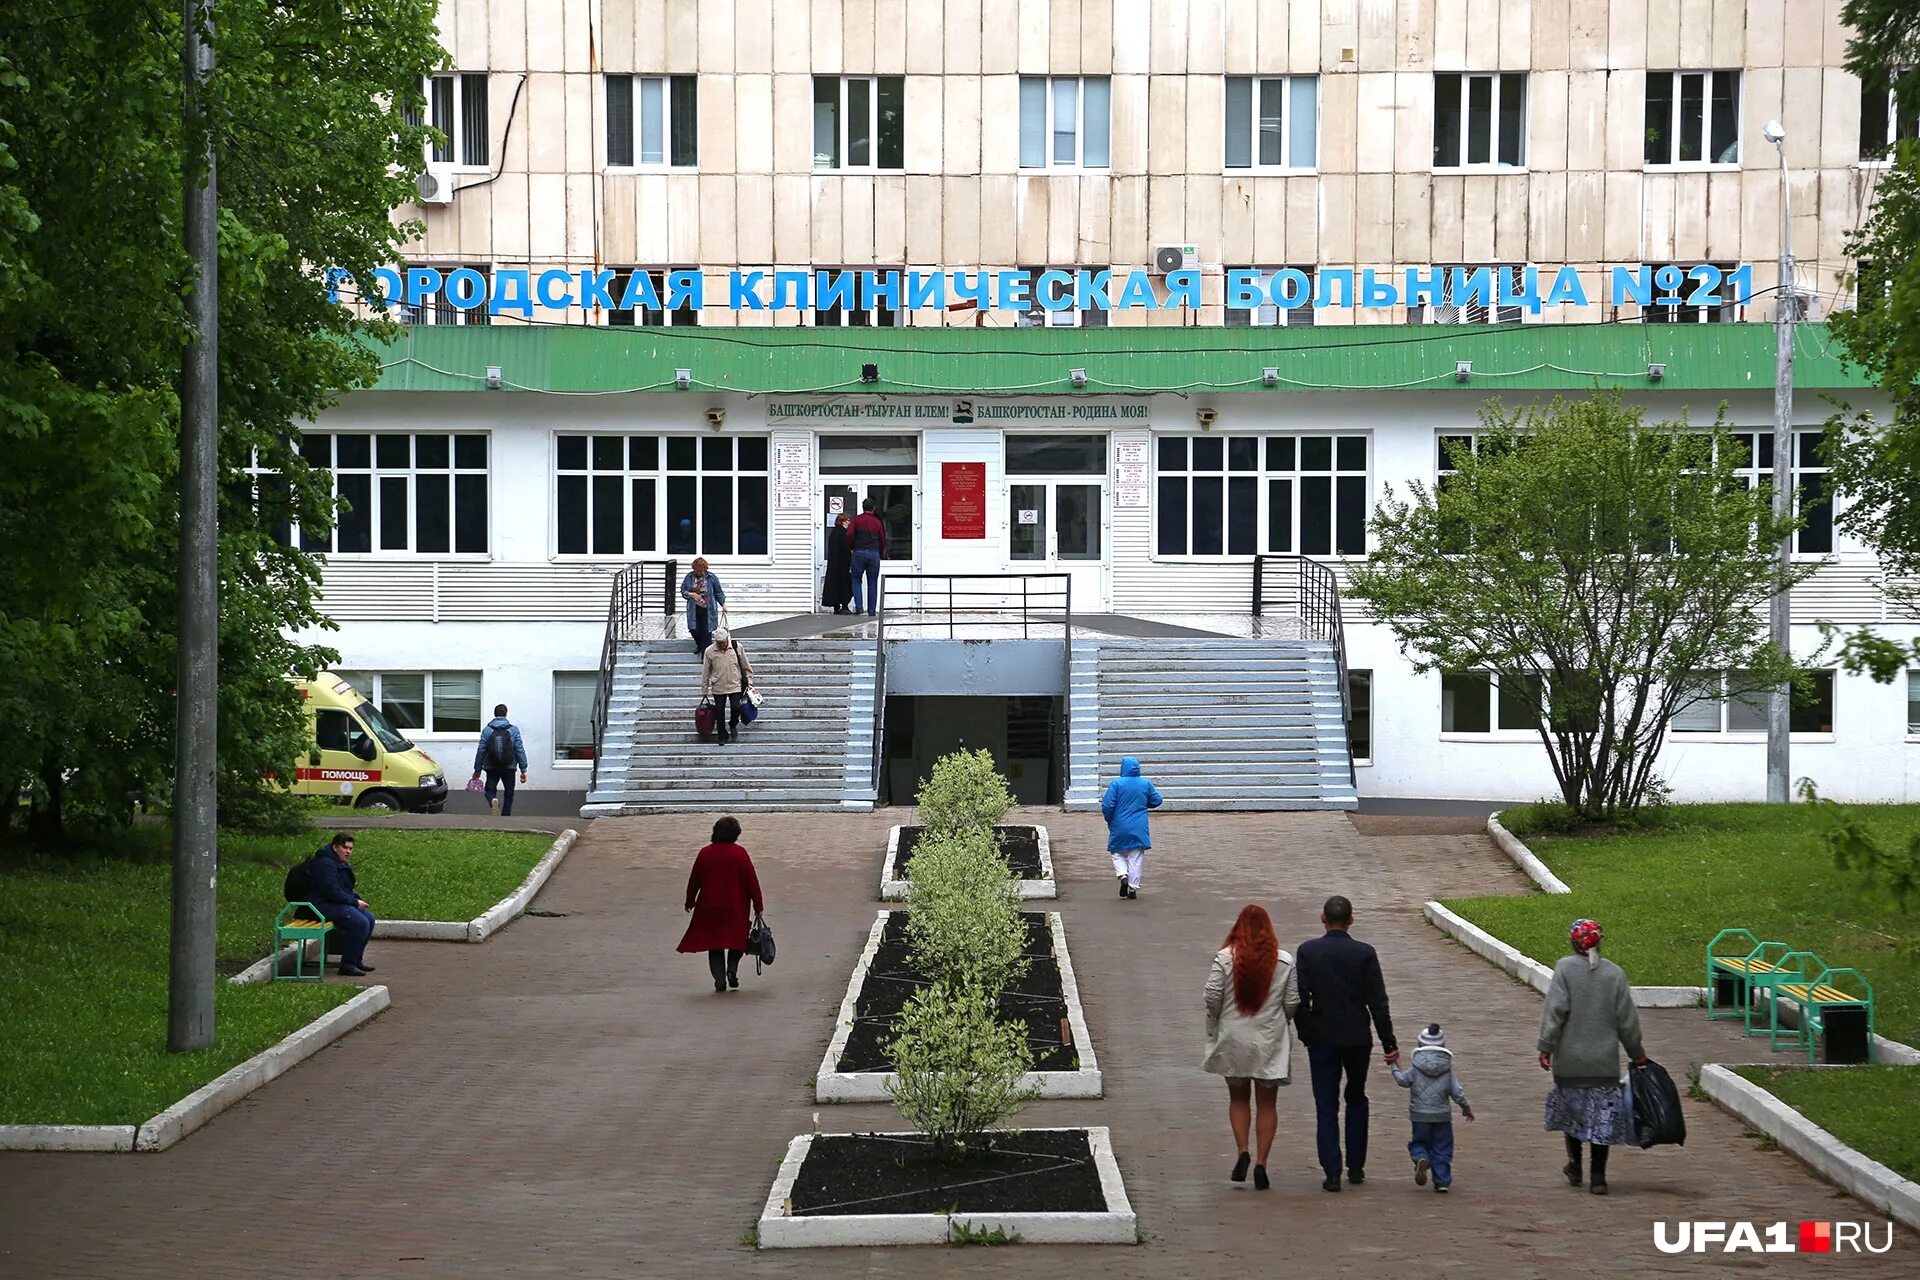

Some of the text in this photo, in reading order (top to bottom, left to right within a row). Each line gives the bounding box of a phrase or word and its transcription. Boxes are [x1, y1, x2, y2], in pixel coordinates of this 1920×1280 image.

[728, 269, 1202, 312] КЛИНИЧЕСКАЯ
[1227, 266, 1588, 316] БОЛЬНИЦА
[1611, 264, 1753, 306] №21
[1072, 405, 1118, 421] РОДИНА
[1120, 405, 1149, 419] МОЯ!
[321, 770, 369, 781] ПОМОЩЬ
